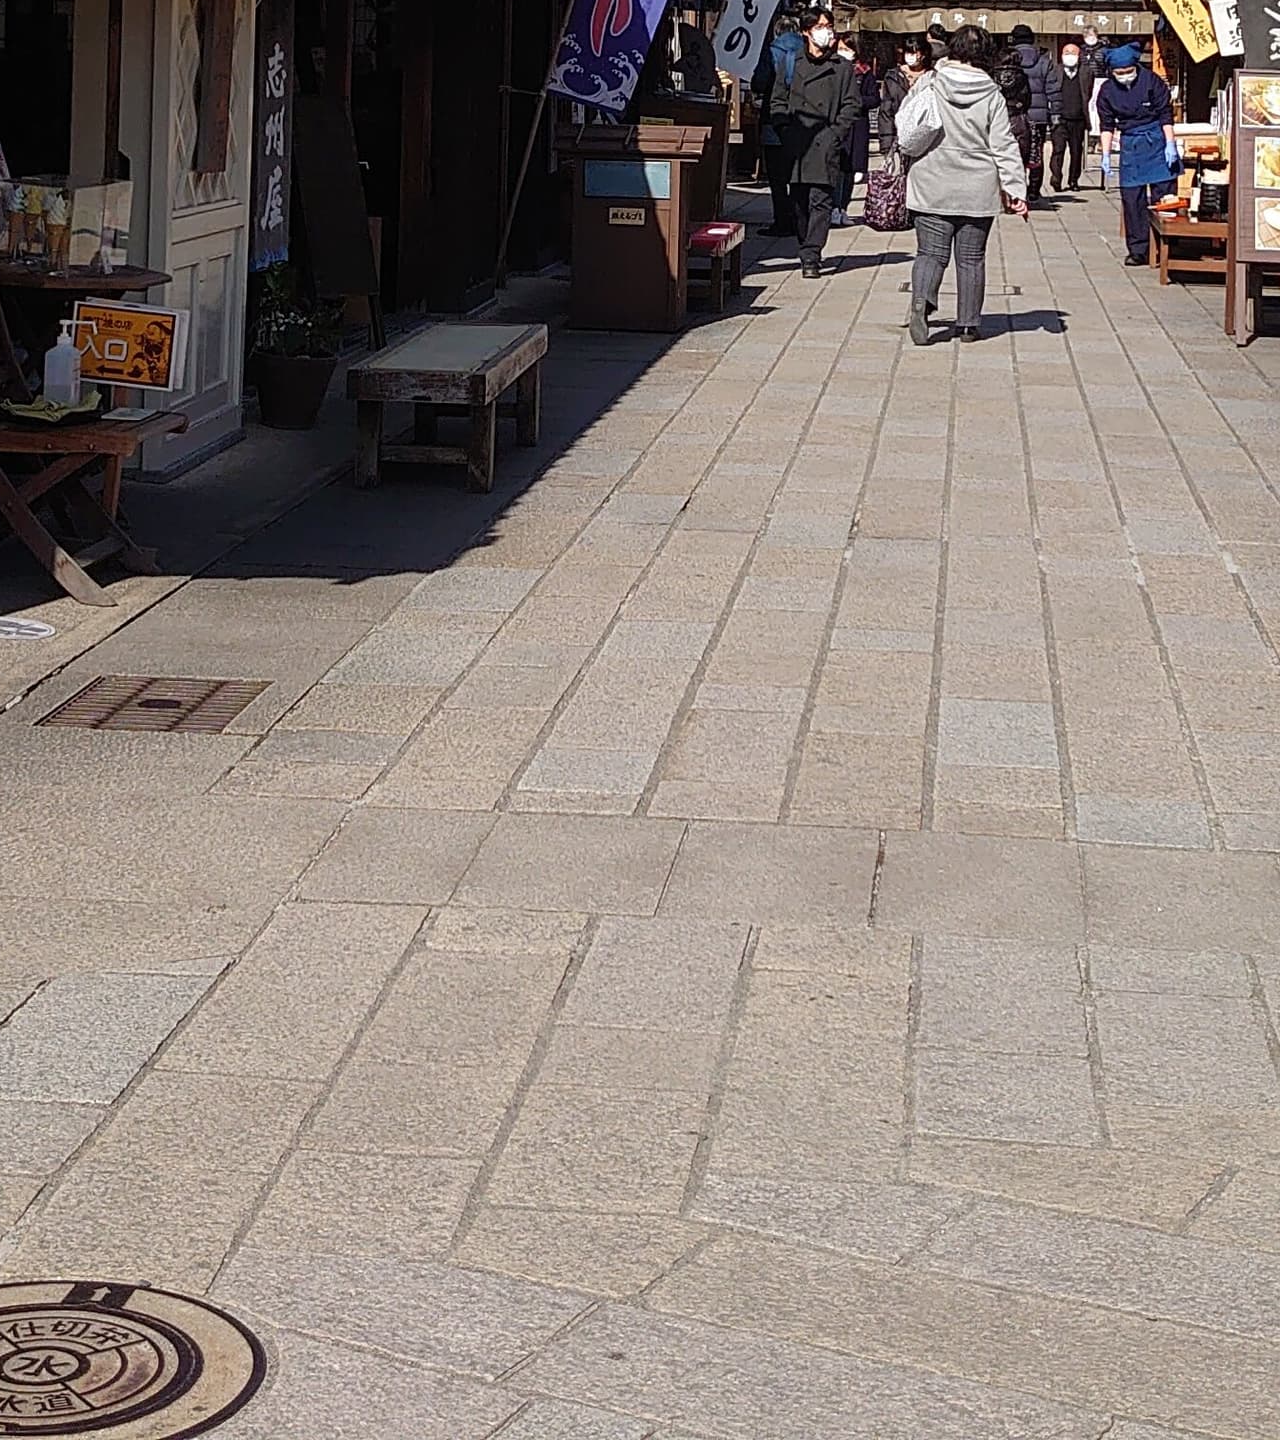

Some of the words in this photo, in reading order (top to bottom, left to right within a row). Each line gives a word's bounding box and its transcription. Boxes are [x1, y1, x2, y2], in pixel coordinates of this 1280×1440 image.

[260, 42, 288, 231] 志州屋
[6, 1319, 132, 1345] 仕切弁
[7, 1355, 70, 1377] 水
